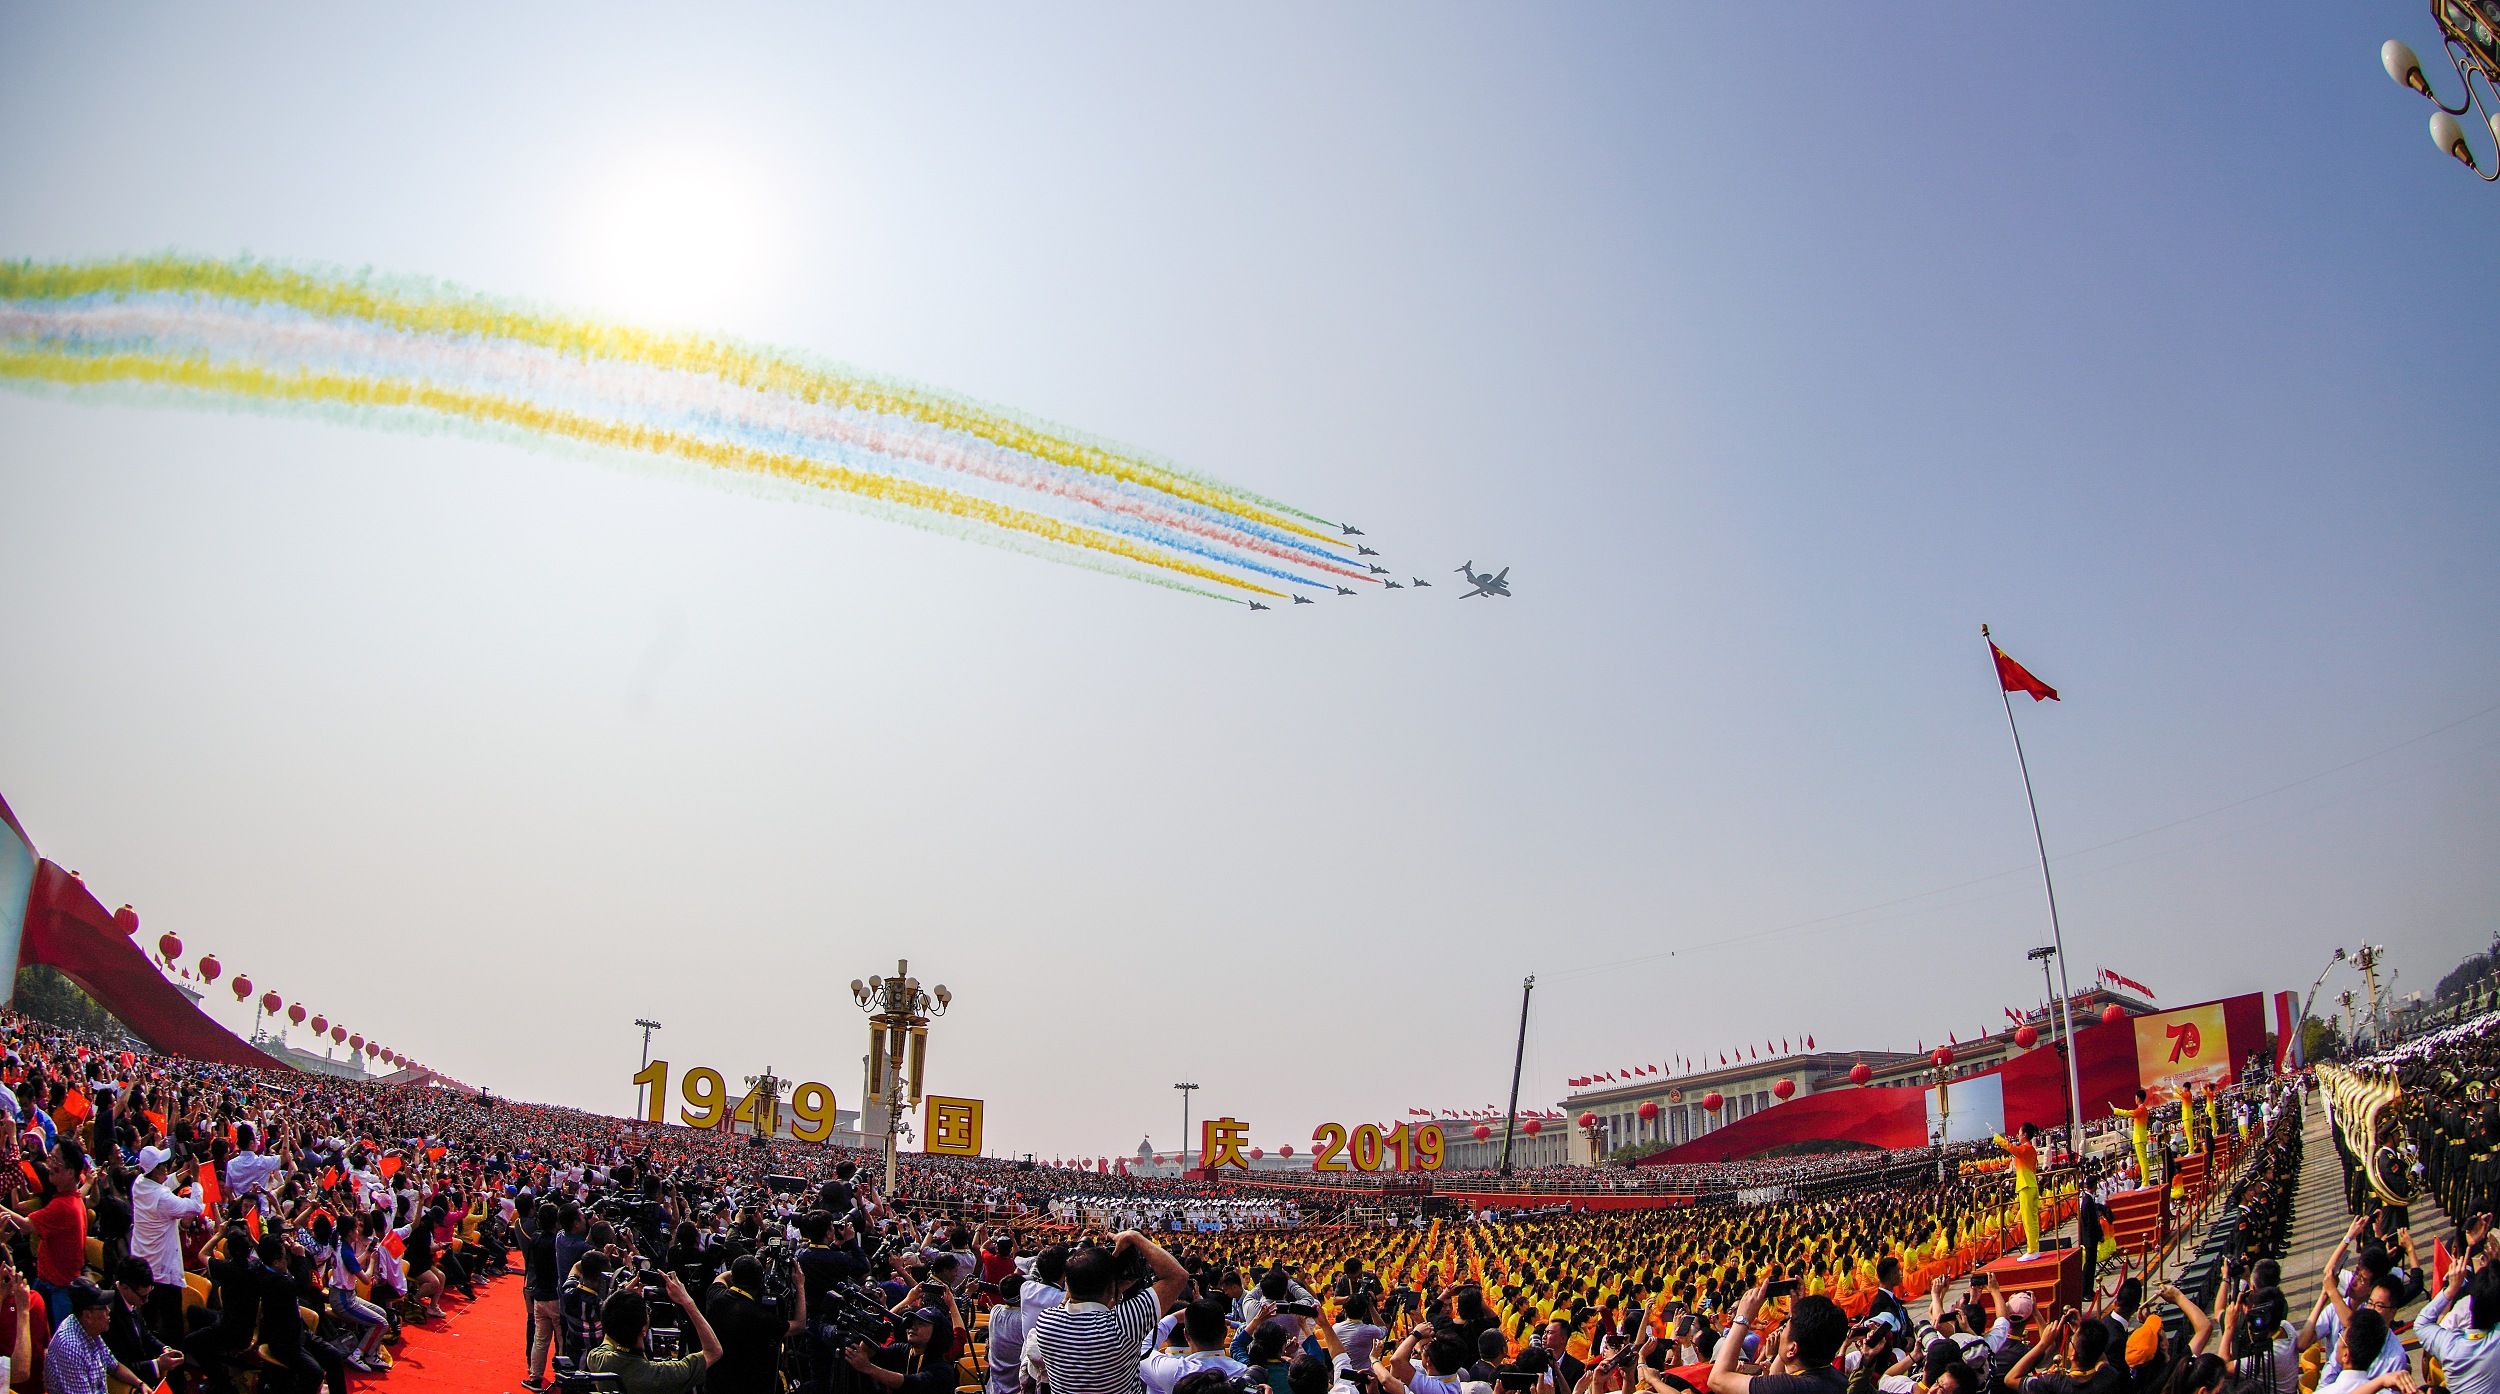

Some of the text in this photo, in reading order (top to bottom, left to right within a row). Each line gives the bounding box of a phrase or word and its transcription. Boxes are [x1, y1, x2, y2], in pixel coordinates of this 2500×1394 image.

[924, 1094, 984, 1156] 国
[1202, 1117, 1249, 1169] 庆
[1312, 1119, 1446, 1172] 2019
